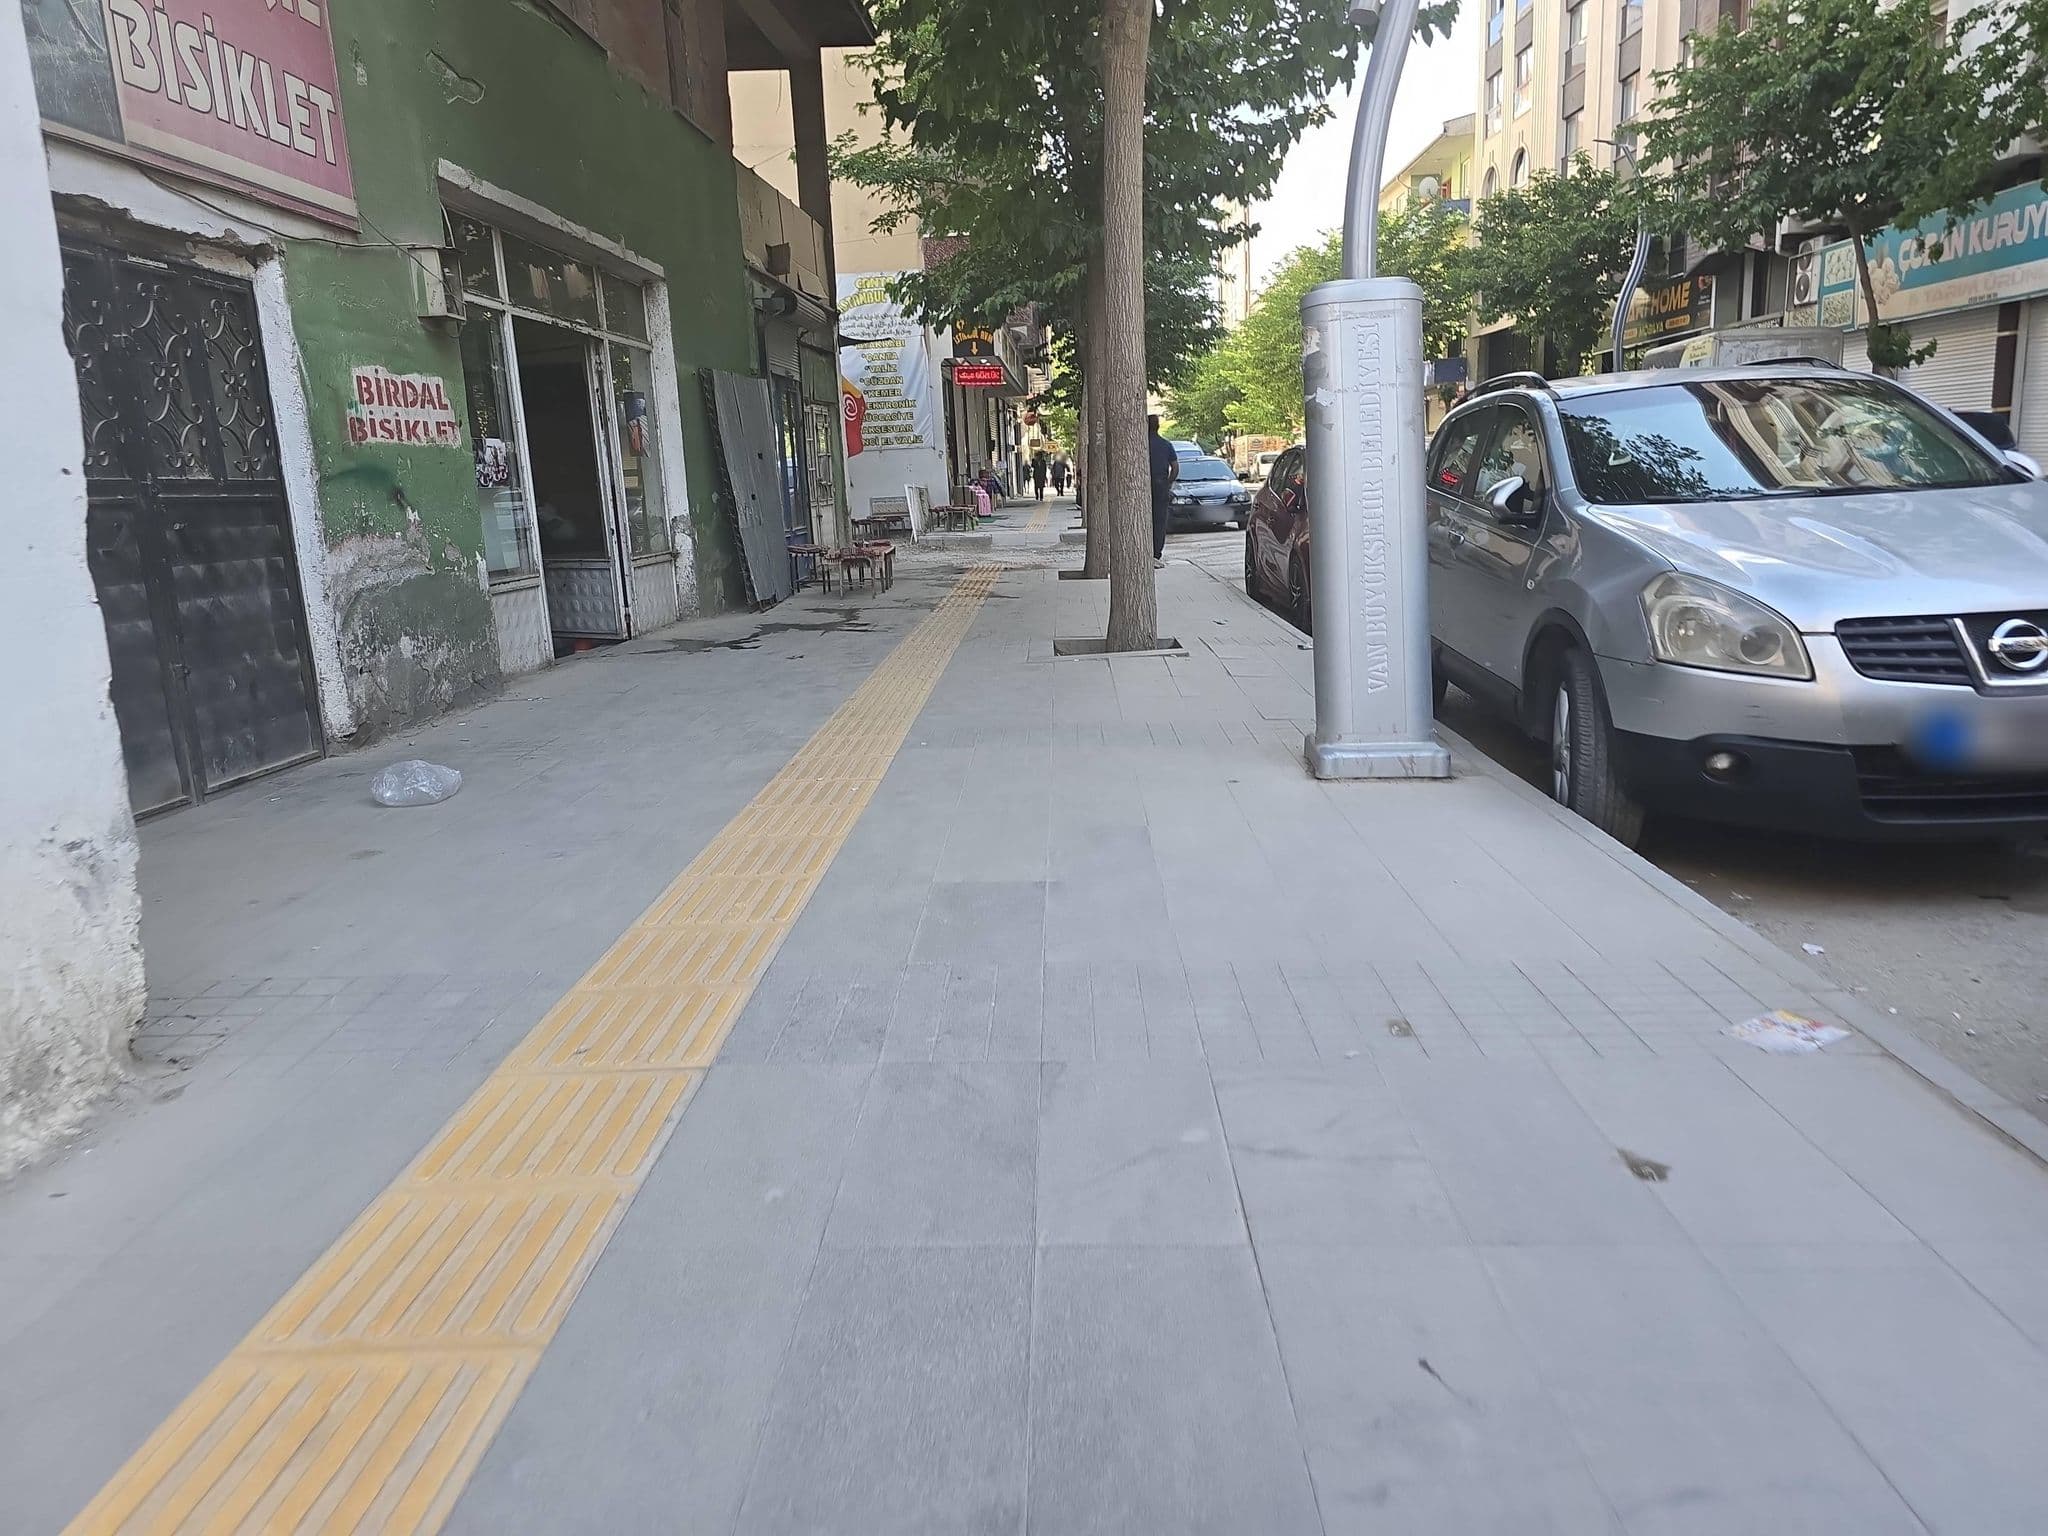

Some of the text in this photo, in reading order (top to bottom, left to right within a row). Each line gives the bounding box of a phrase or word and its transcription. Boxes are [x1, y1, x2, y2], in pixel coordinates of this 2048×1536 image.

[108, 0, 337, 166] BİSİKLET
[1968, 200, 2048, 255] KURUY
[1650, 280, 1692, 316] HOME
[356, 368, 449, 410] BİRDAL
[866, 399, 917, 410] EKTRONİK
[867, 389, 902, 398] KEMER
[349, 410, 458, 442] BİSİKLET
[1352, 322, 1391, 695] VAN BÜYÜKŞEHİR BELEDİYESİ
